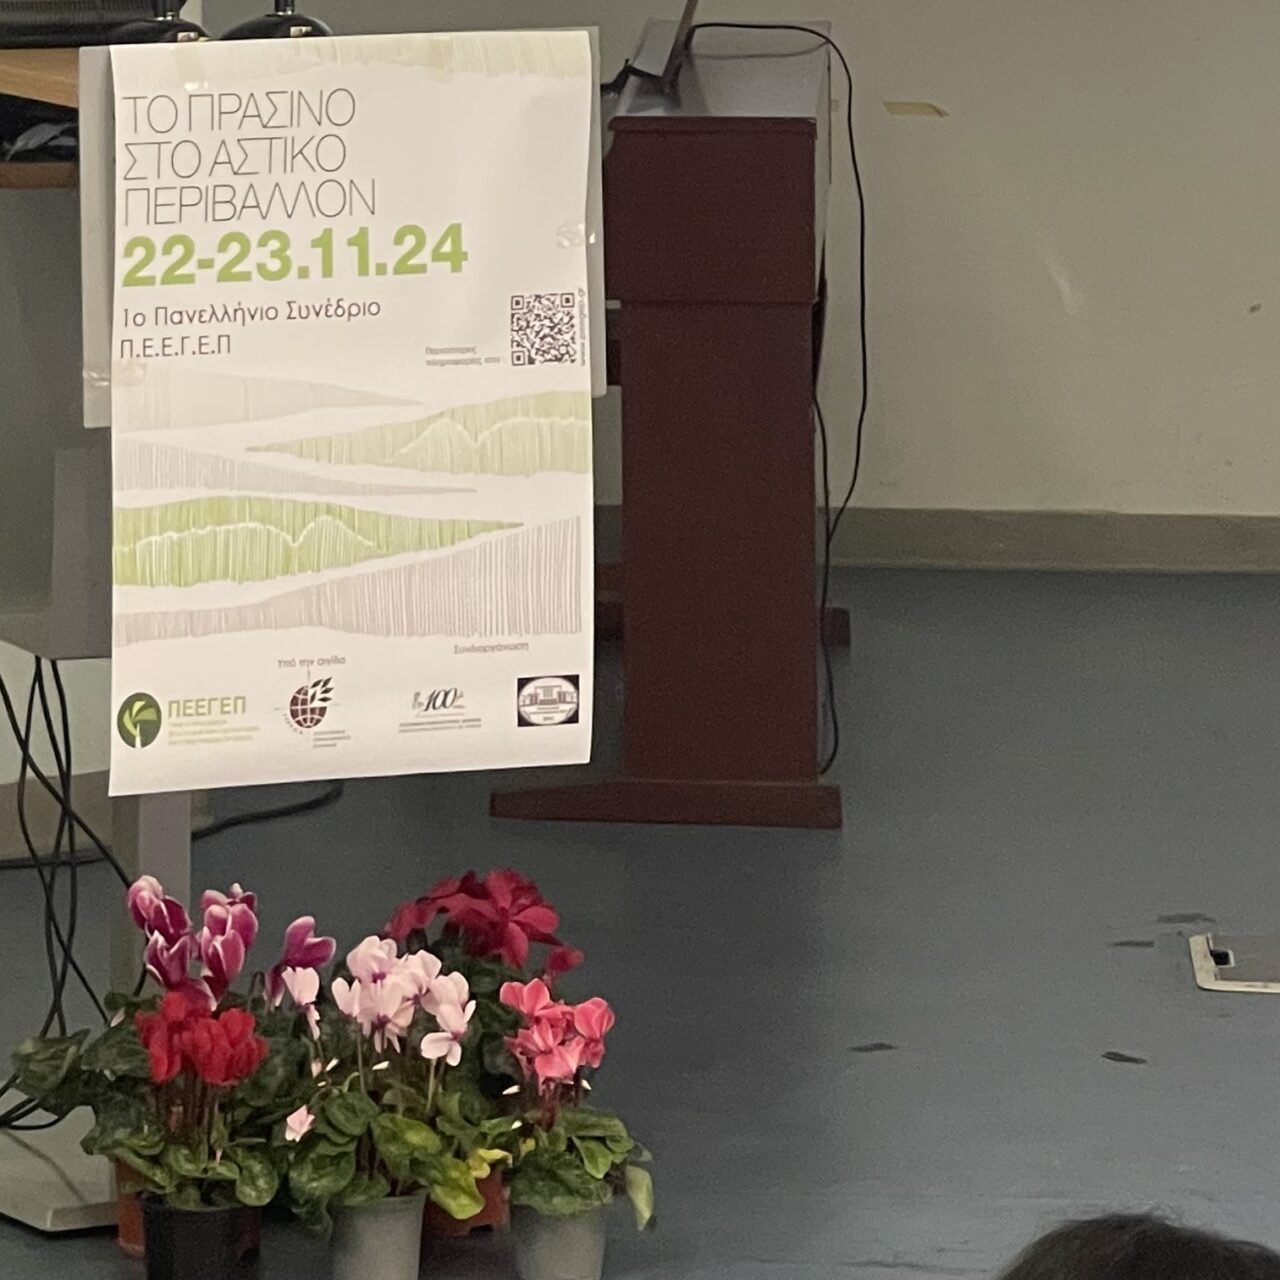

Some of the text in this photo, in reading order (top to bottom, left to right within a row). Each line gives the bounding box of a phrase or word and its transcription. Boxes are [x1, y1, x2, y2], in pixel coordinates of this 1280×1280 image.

[122, 88, 355, 134] ΤΟ ΠΡΑΣΙΝΟ
[123, 134, 346, 180] ΣΤΟ ΑΣΤΙΚΟ
[123, 178, 376, 225] ΠΕΡΙΒΑΛΛΟΝ
[123, 223, 468, 286] 22-23.11.24
[155, 302, 278, 326] Πανελλήνιο
[287, 298, 380, 321] Συνέδριο
[121, 335, 230, 359] Π.Ε.Ε.Γ.Ε.Π
[168, 696, 246, 717] ΠΕΕΓΕΠ
